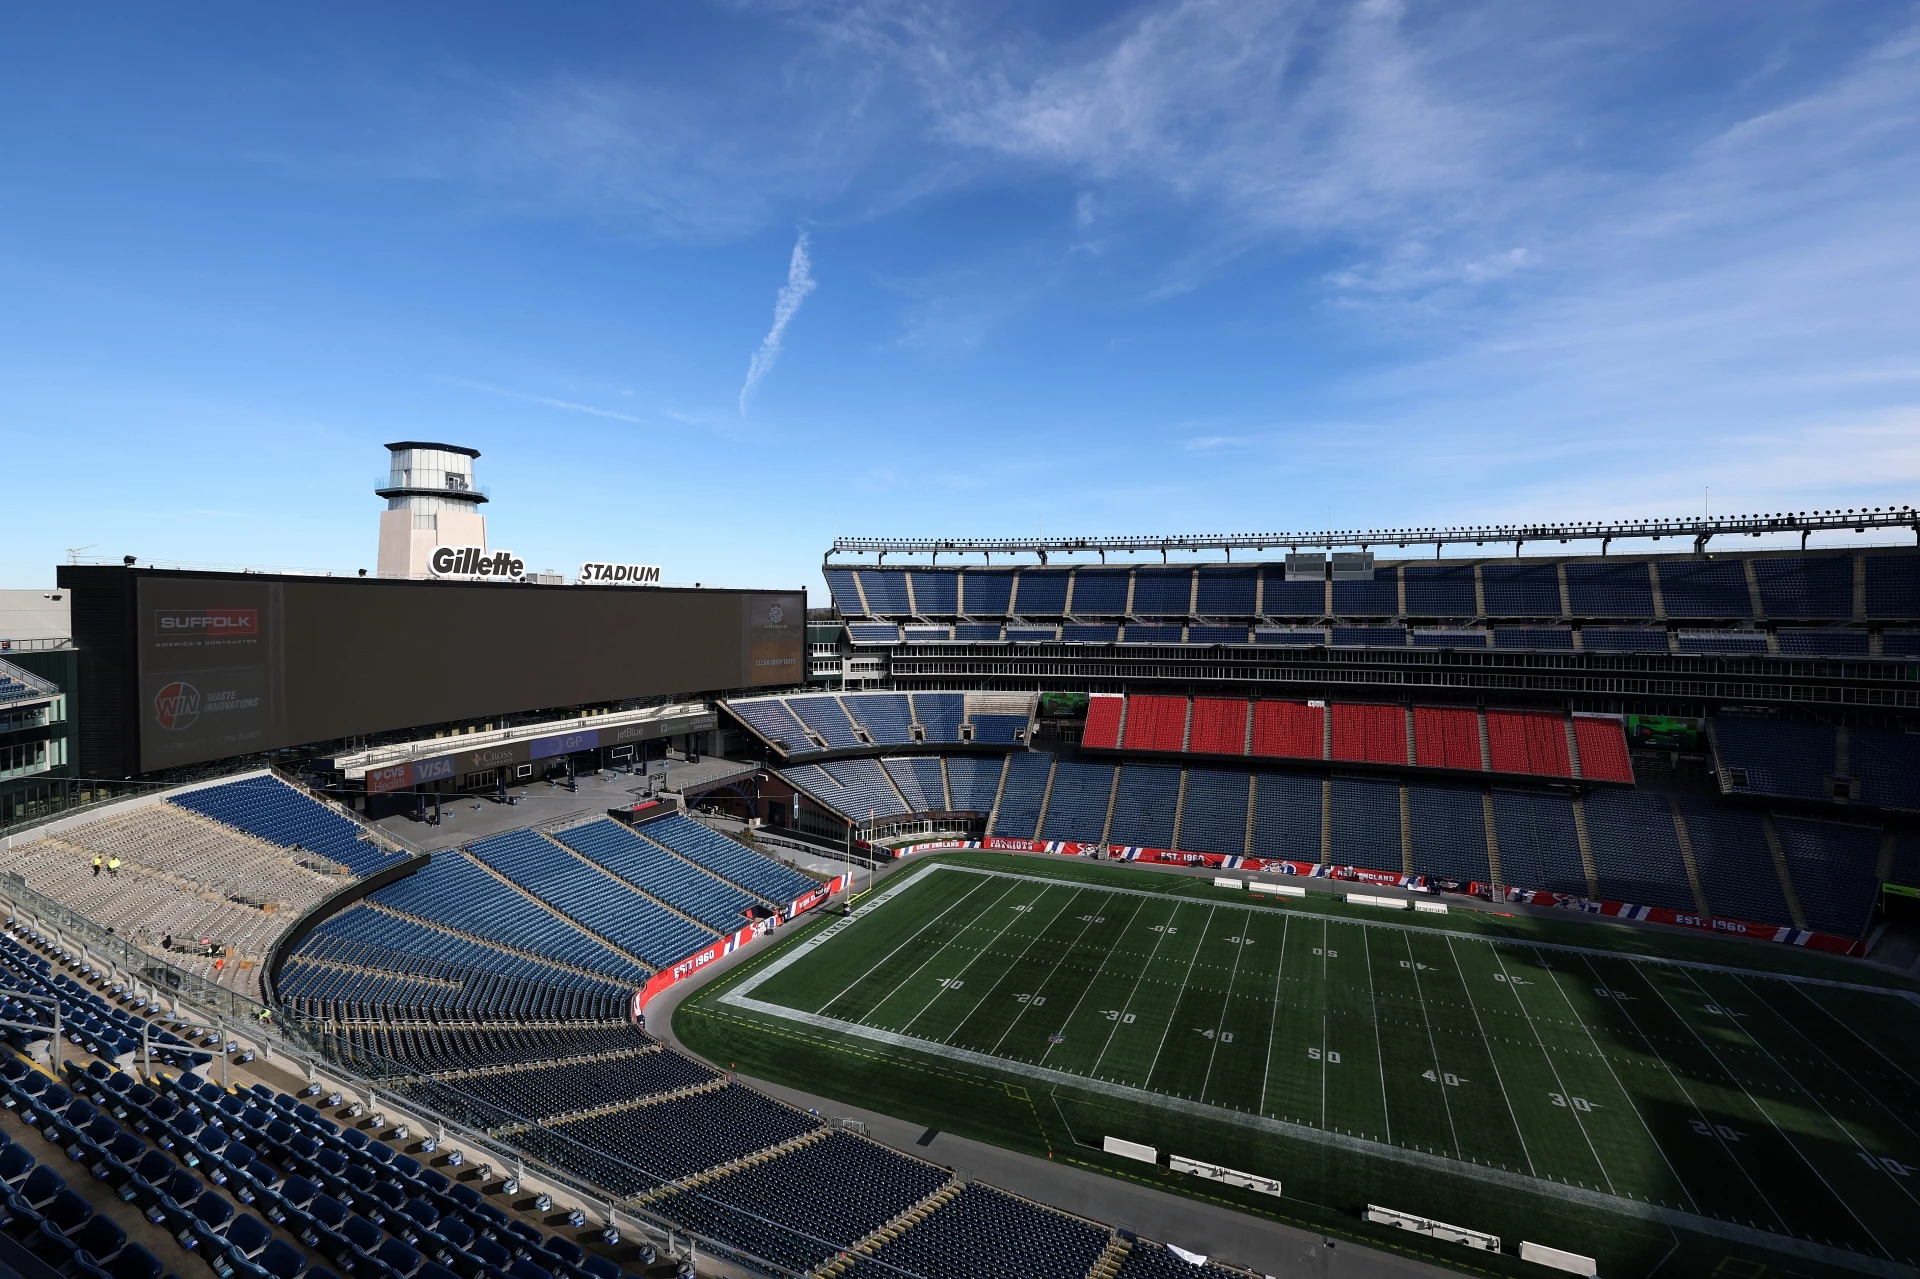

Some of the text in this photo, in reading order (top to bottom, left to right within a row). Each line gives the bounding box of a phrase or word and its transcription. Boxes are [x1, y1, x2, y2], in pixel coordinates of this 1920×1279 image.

[433, 547, 660, 582] Gillette STADIUM
[160, 616, 251, 629] SUFFOLK
[155, 640, 202, 648] AMERICA'S
[206, 690, 237, 702] WASTE
[158, 694, 197, 718] WIN
[204, 698, 259, 713] INNOVATIONS
[617, 727, 644, 741] jetBlue
[383, 766, 405, 779] CVS
[416, 760, 451, 779] VISA
[374, 778, 405, 792] Health
[916, 841, 959, 851] NEW ENGLAND
[990, 840, 1033, 851] PATRIOTS
[1675, 913, 1747, 933] EST. 1960
[695, 949, 715, 967] 1960
[1312, 947, 1338, 958] 50
[940, 978, 965, 990] 10
[1016, 993, 1047, 1006] 20
[1105, 1010, 1137, 1024] 30
[1202, 1028, 1234, 1043] 40
[1308, 1047, 1341, 1063] 50
[1421, 1069, 1459, 1087] 40
[1548, 1092, 1592, 1112] 30
[1688, 1119, 1740, 1142] 20
[1856, 1152, 1911, 1177] 10
